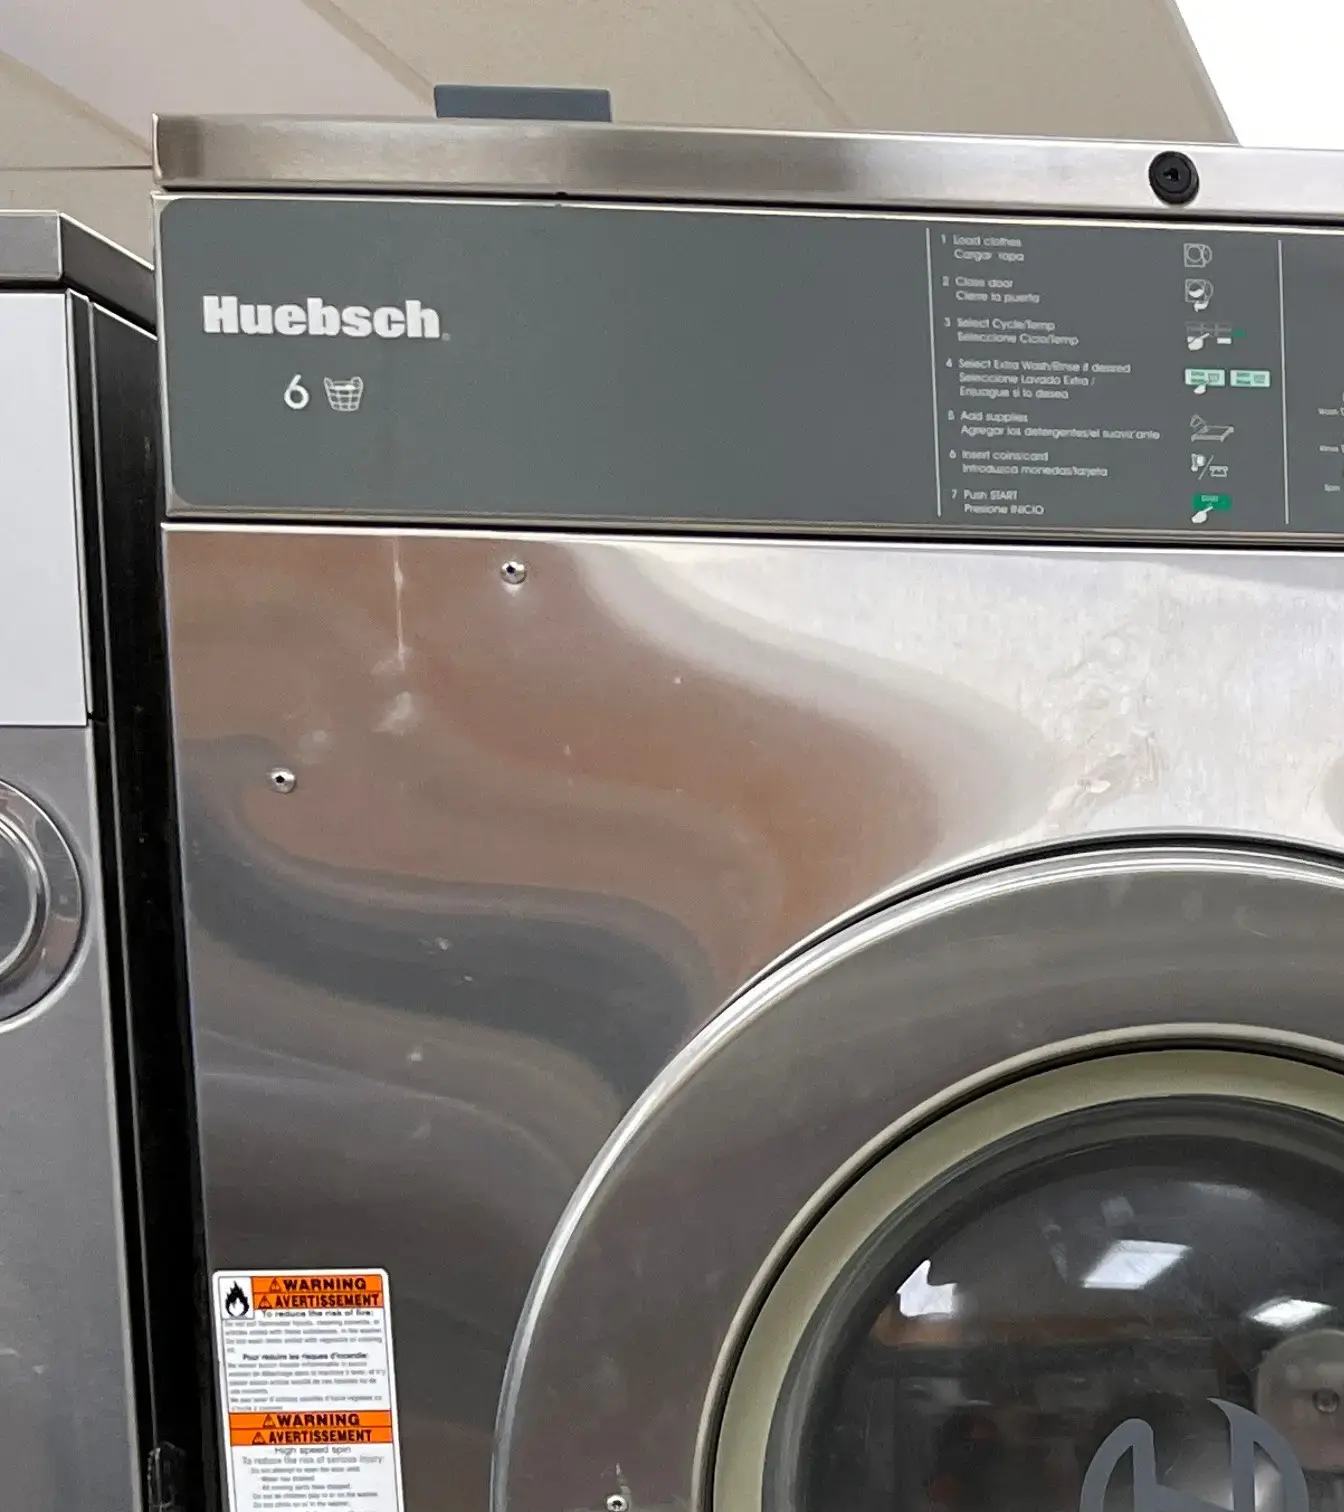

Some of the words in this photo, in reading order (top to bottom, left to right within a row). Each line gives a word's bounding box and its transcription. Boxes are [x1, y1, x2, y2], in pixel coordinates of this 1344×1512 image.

[953, 234, 981, 246] Load
[983, 237, 1021, 247] clothes
[954, 248, 992, 262] Cargar
[998, 252, 1024, 262] ropa
[955, 276, 985, 287] Close
[987, 278, 1013, 288] door
[1004, 294, 1040, 304] puerta
[203, 295, 440, 338] Huebsch
[944, 317, 951, 328] 3
[957, 317, 989, 329] Select
[992, 318, 1056, 332] Cycle/Temp
[957, 331, 1017, 343] Seleccione
[946, 358, 953, 368] 4
[958, 358, 991, 369] Select
[994, 360, 1019, 371] Extra
[1021, 360, 1080, 372] Wash/Rinse
[1091, 363, 1131, 374] desired
[959, 372, 1018, 384] Seleccione
[1021, 374, 1061, 385] Lavado
[1063, 375, 1088, 386] Extra
[284, 374, 310, 410] 6
[1036, 389, 1069, 399] desea
[960, 410, 982, 421] Add
[986, 411, 1028, 423] supplies
[961, 425, 1004, 437] Agregar
[1007, 427, 1021, 437] los
[949, 449, 956, 459] 6
[962, 450, 990, 460] Insert
[951, 488, 958, 499] 7
[963, 489, 988, 500] Push
[990, 489, 1018, 500] START
[964, 503, 1008, 515] Presione
[1010, 504, 1045, 515] INICIO
[283, 1278, 366, 1291] WARNING
[275, 1294, 379, 1308] AVERTISSEMENT
[263, 1310, 272, 1318] To
[275, 1310, 305, 1318] reduce
[308, 1310, 322, 1318] the
[325, 1310, 342, 1318] risk
[344, 1310, 354, 1318] of
[278, 1414, 359, 1427] WARNING
[269, 1429, 372, 1443] AVERTISSEMENT
[300, 1446, 328, 1455] speed
